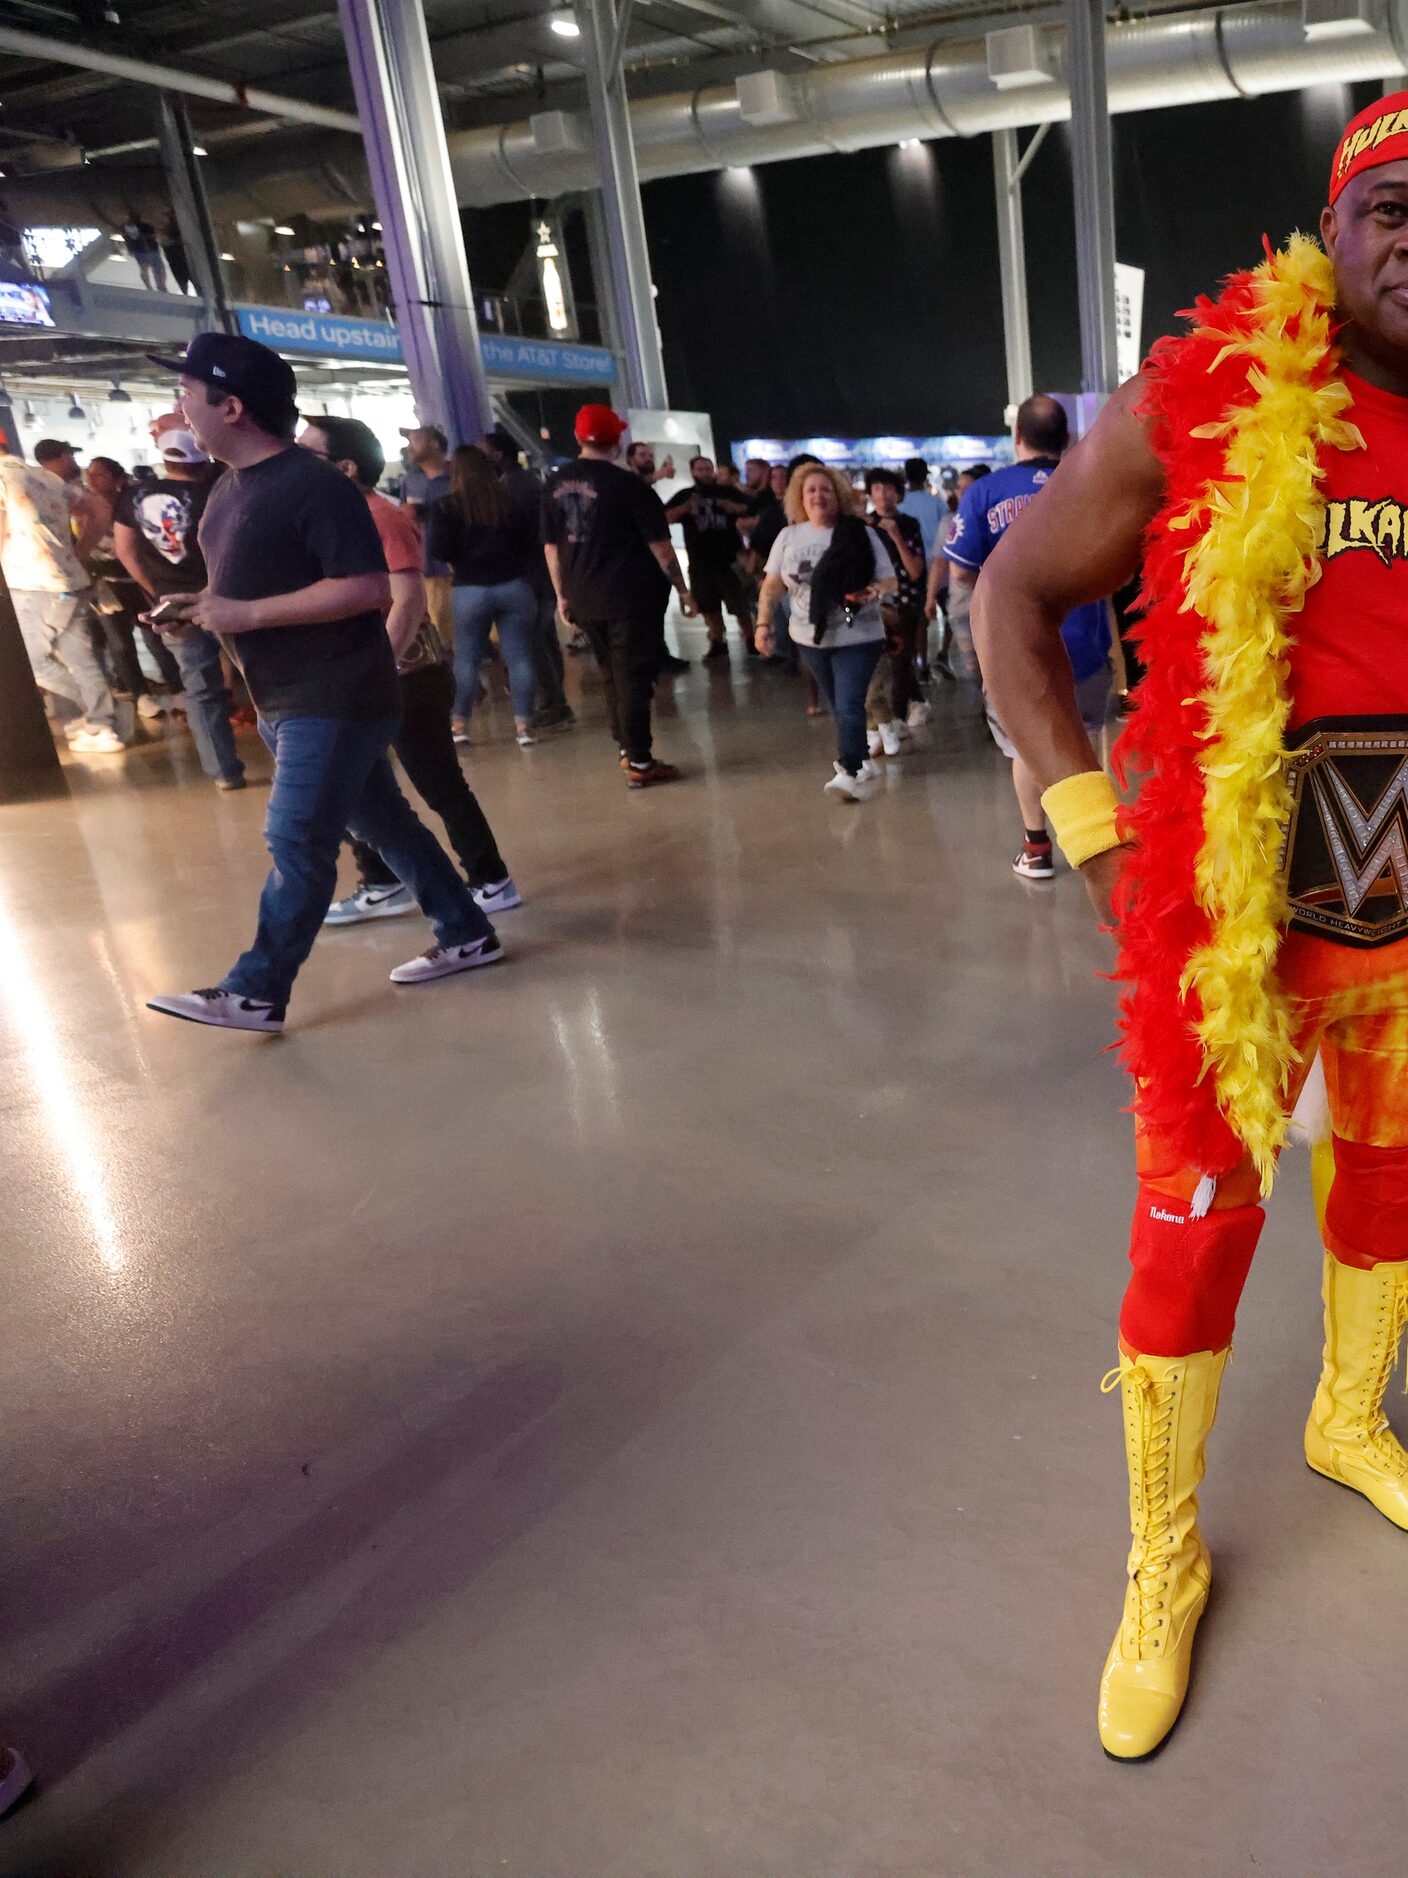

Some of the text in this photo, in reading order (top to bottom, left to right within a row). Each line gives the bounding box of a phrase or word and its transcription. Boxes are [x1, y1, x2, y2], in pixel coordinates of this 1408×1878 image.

[249, 313, 317, 341] Head
[321, 325, 399, 350] upstair
[1330, 919, 1403, 938] HEAVYWEIGHT
